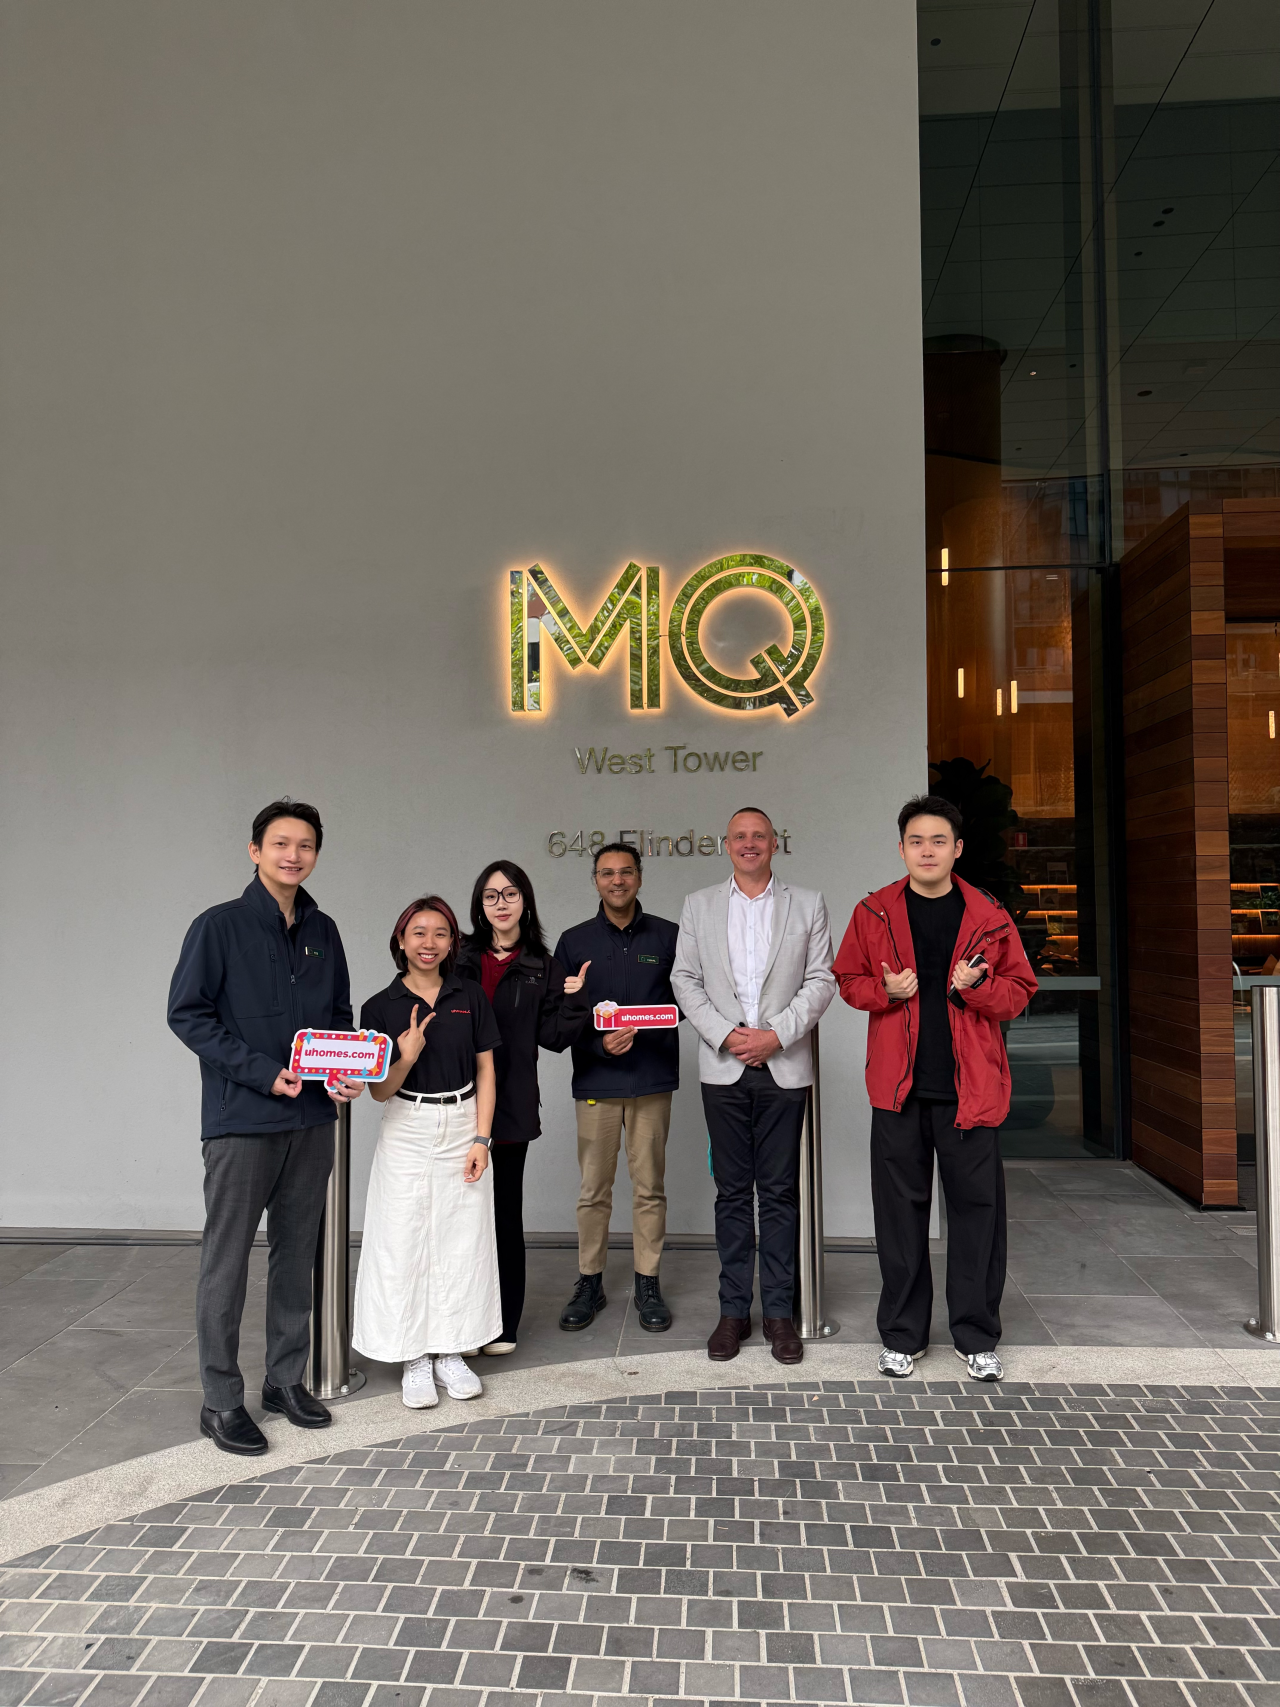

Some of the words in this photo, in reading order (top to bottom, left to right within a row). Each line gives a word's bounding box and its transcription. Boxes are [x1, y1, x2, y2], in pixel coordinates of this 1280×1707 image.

[509, 553, 826, 719] MQ
[574, 746, 655, 775] West
[665, 744, 764, 774] Tower
[548, 829, 605, 858] 648
[619, 828, 728, 857] Flinder
[619, 1013, 674, 1022] uhomes.com
[304, 1047, 375, 1060] uhomes.com
